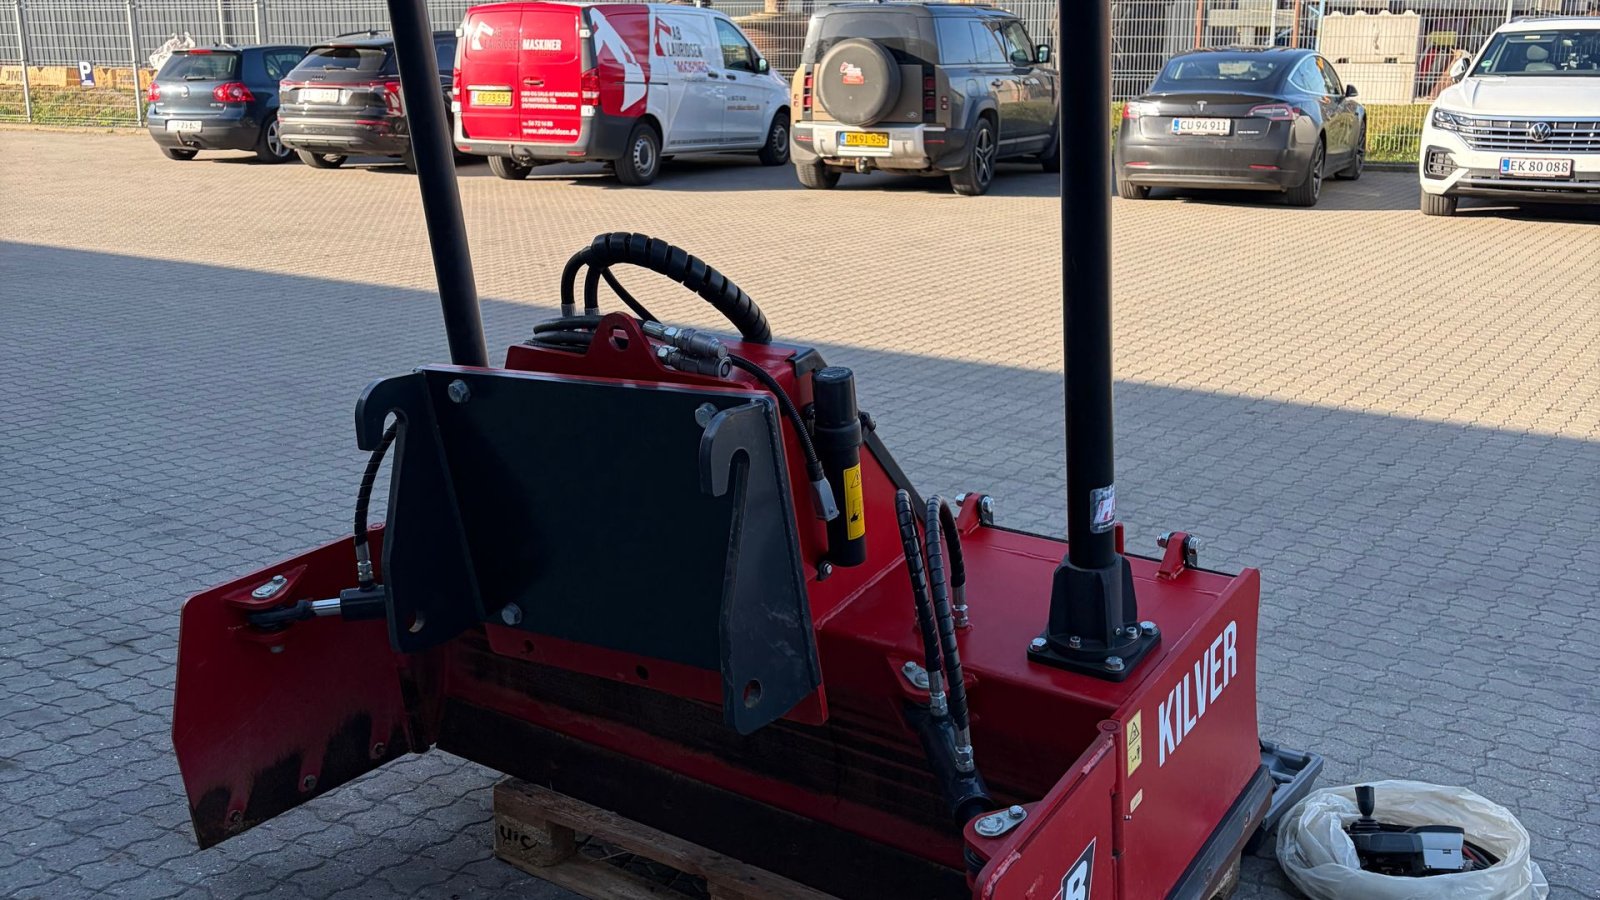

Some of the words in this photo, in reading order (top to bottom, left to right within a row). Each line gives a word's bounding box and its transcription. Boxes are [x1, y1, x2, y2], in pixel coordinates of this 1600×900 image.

[522, 38, 562, 51] MASKINER
[79, 61, 91, 80] P
[1180, 120, 1194, 130] CU
[1195, 120, 1208, 130] 94
[1210, 121, 1227, 131] 911
[846, 134, 858, 144] DM
[859, 134, 868, 144] 91
[1510, 160, 1526, 171] EK
[1528, 161, 1543, 172] 80
[1545, 161, 1569, 173] 088
[1158, 620, 1237, 768] KILVER
